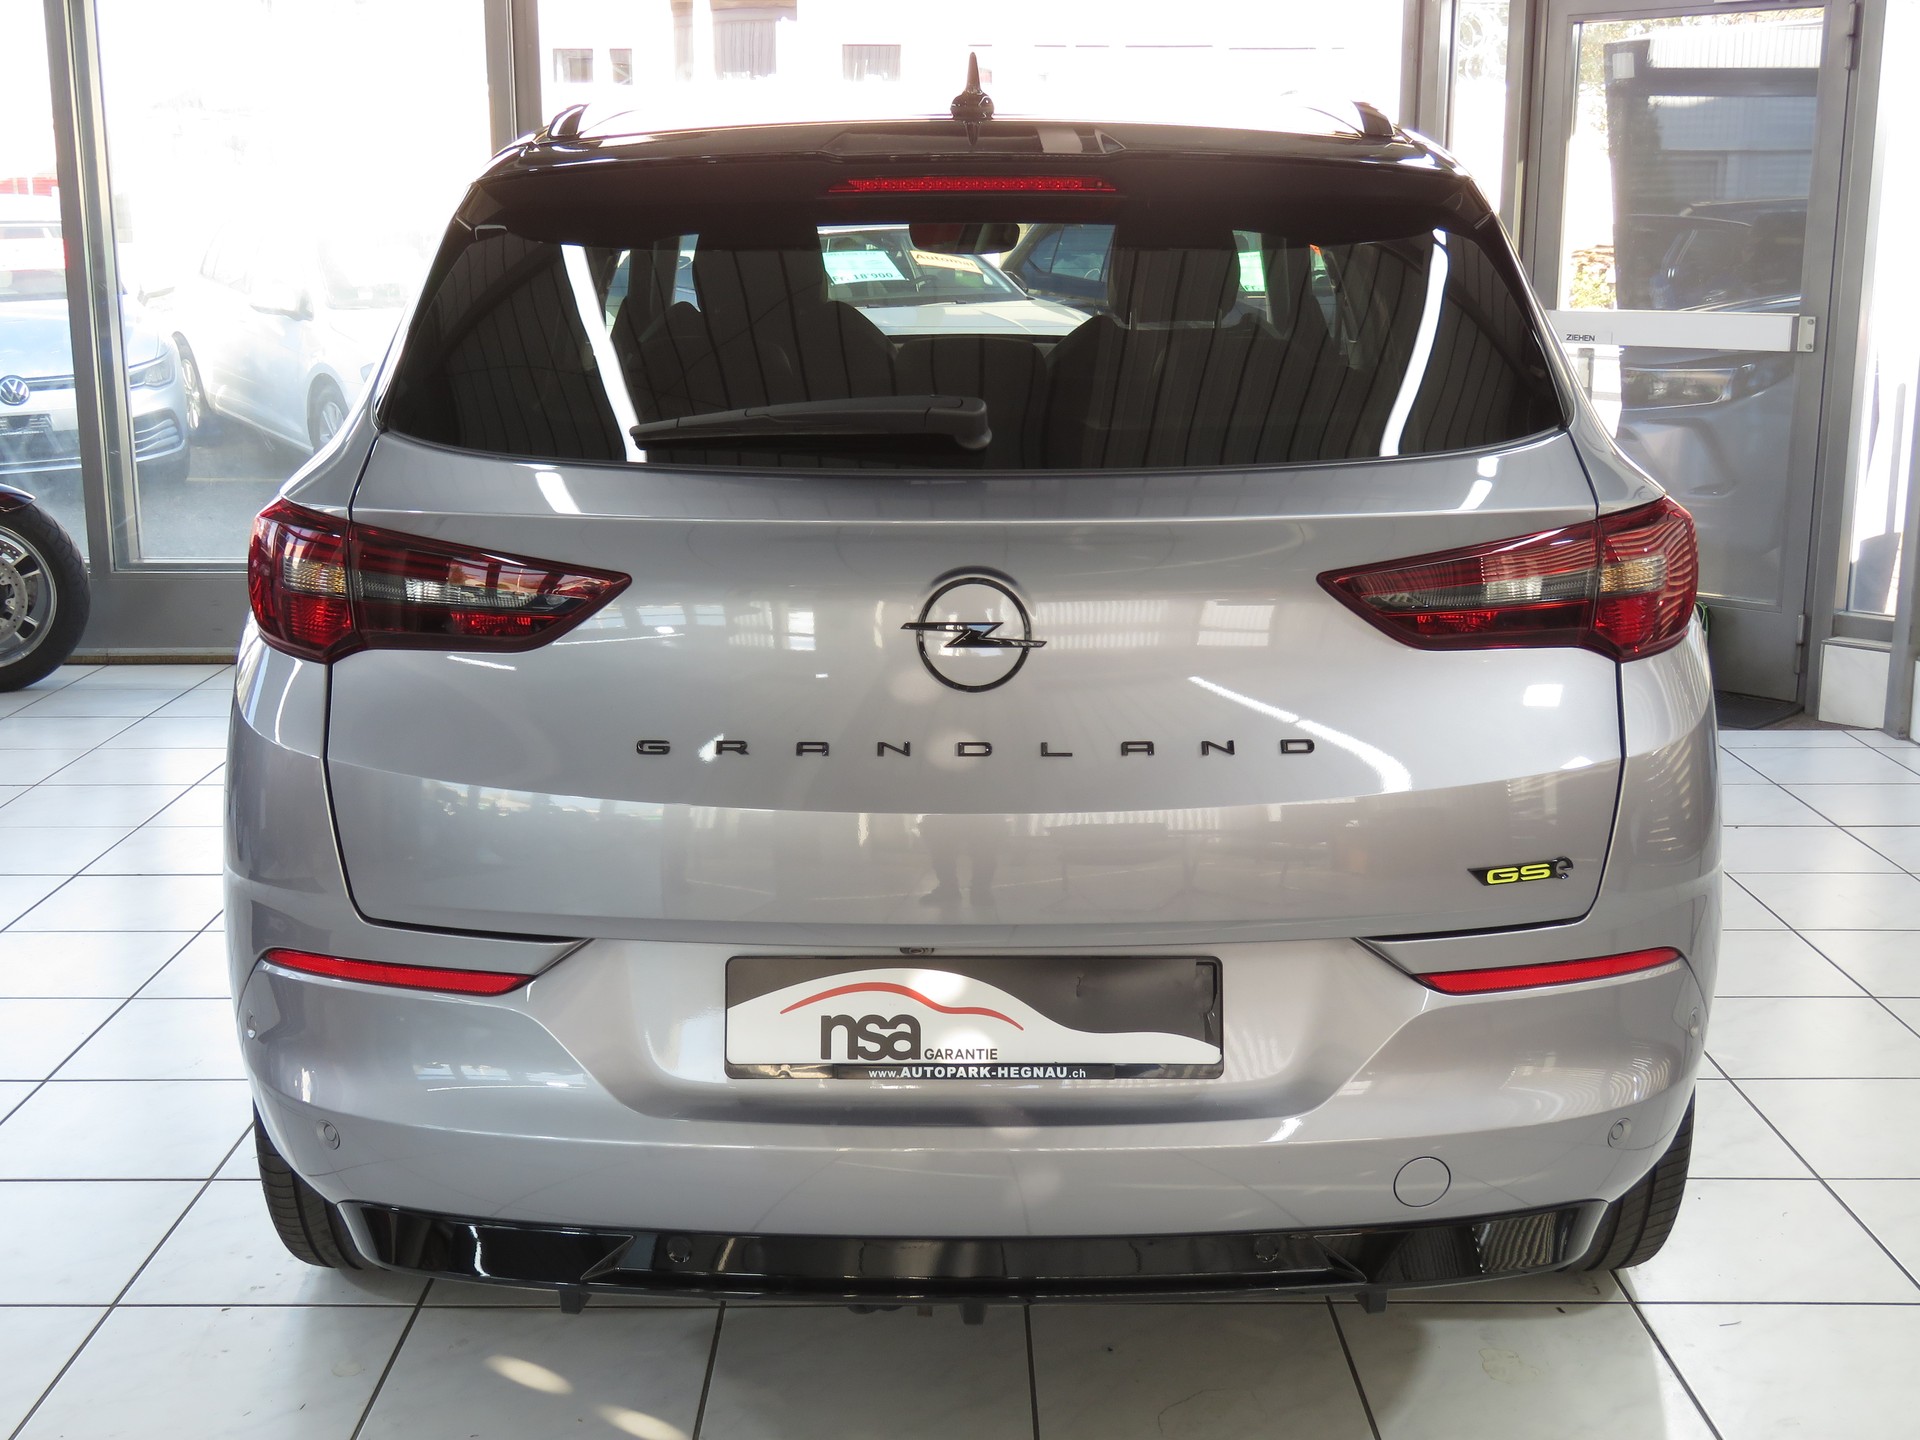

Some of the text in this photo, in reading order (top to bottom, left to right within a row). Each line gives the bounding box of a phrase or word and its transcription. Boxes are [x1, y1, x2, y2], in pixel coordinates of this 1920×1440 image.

[636, 739, 1315, 757] GRANDLAND
[820, 1014, 921, 1061] nsa
[924, 1048, 998, 1060] GARANTIE
[868, 1066, 1086, 1079] www.AUTOPARK-HEGNAU.ch
